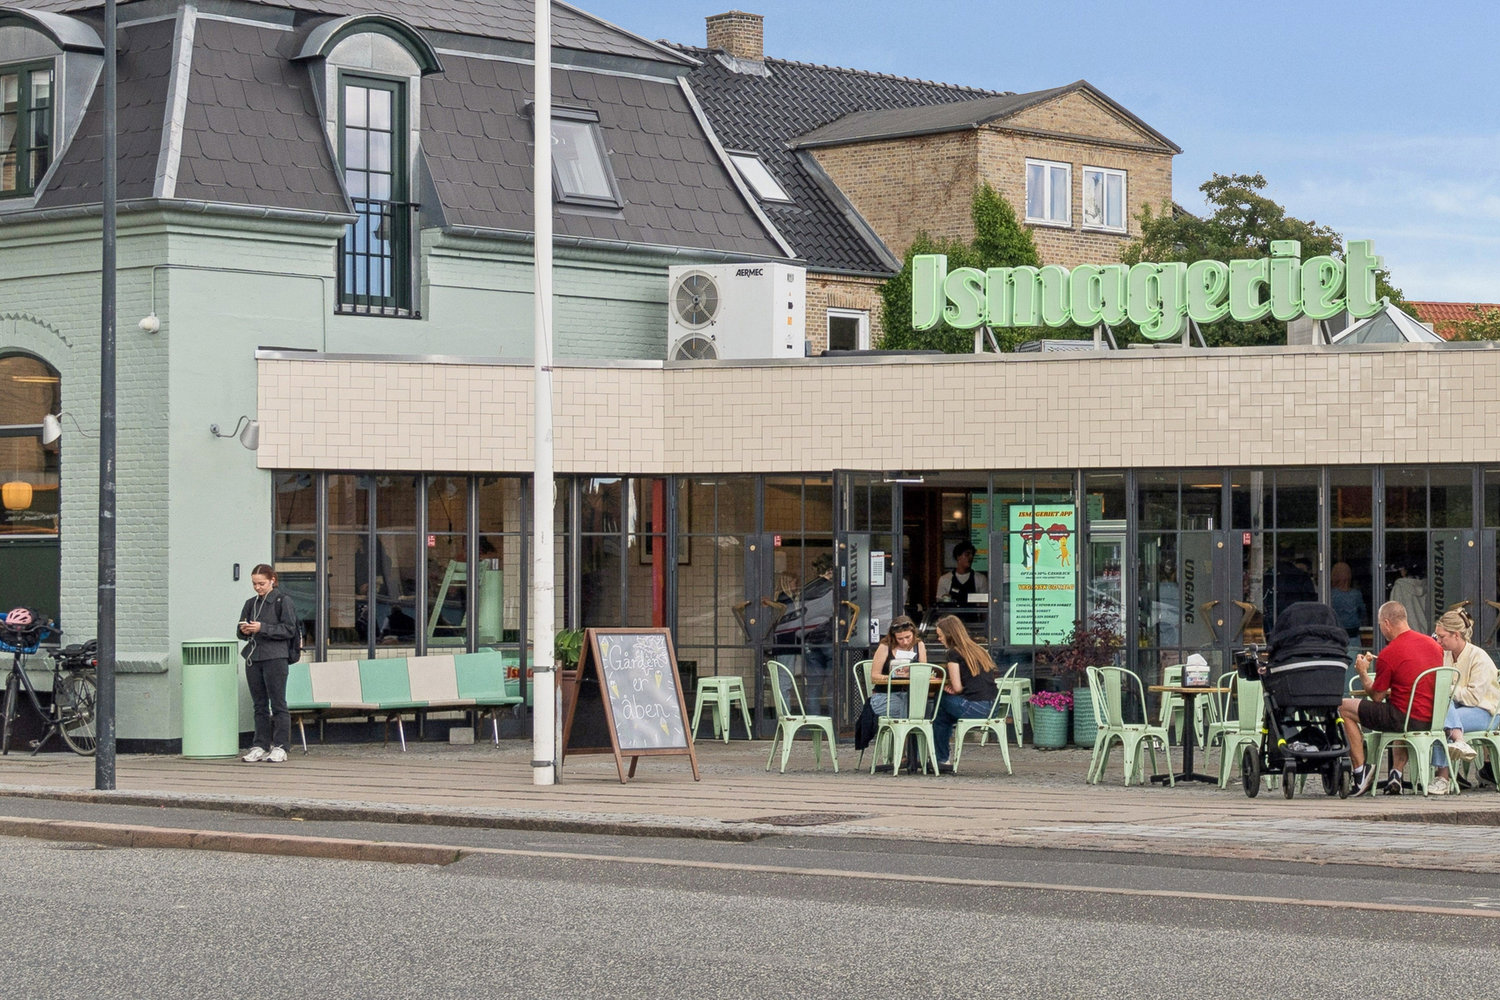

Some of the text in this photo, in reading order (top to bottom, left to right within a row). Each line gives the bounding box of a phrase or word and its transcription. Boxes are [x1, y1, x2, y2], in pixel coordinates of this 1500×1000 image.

[735, 268, 764, 278] AERMEC
[912, 239, 1390, 340] Ismageriet
[1184, 558, 1195, 625] UDGANG
[1434, 540, 1445, 620] WEBORDR
[608, 645, 664, 671] Gården
[633, 677, 649, 692] er
[621, 694, 671, 720] åben
